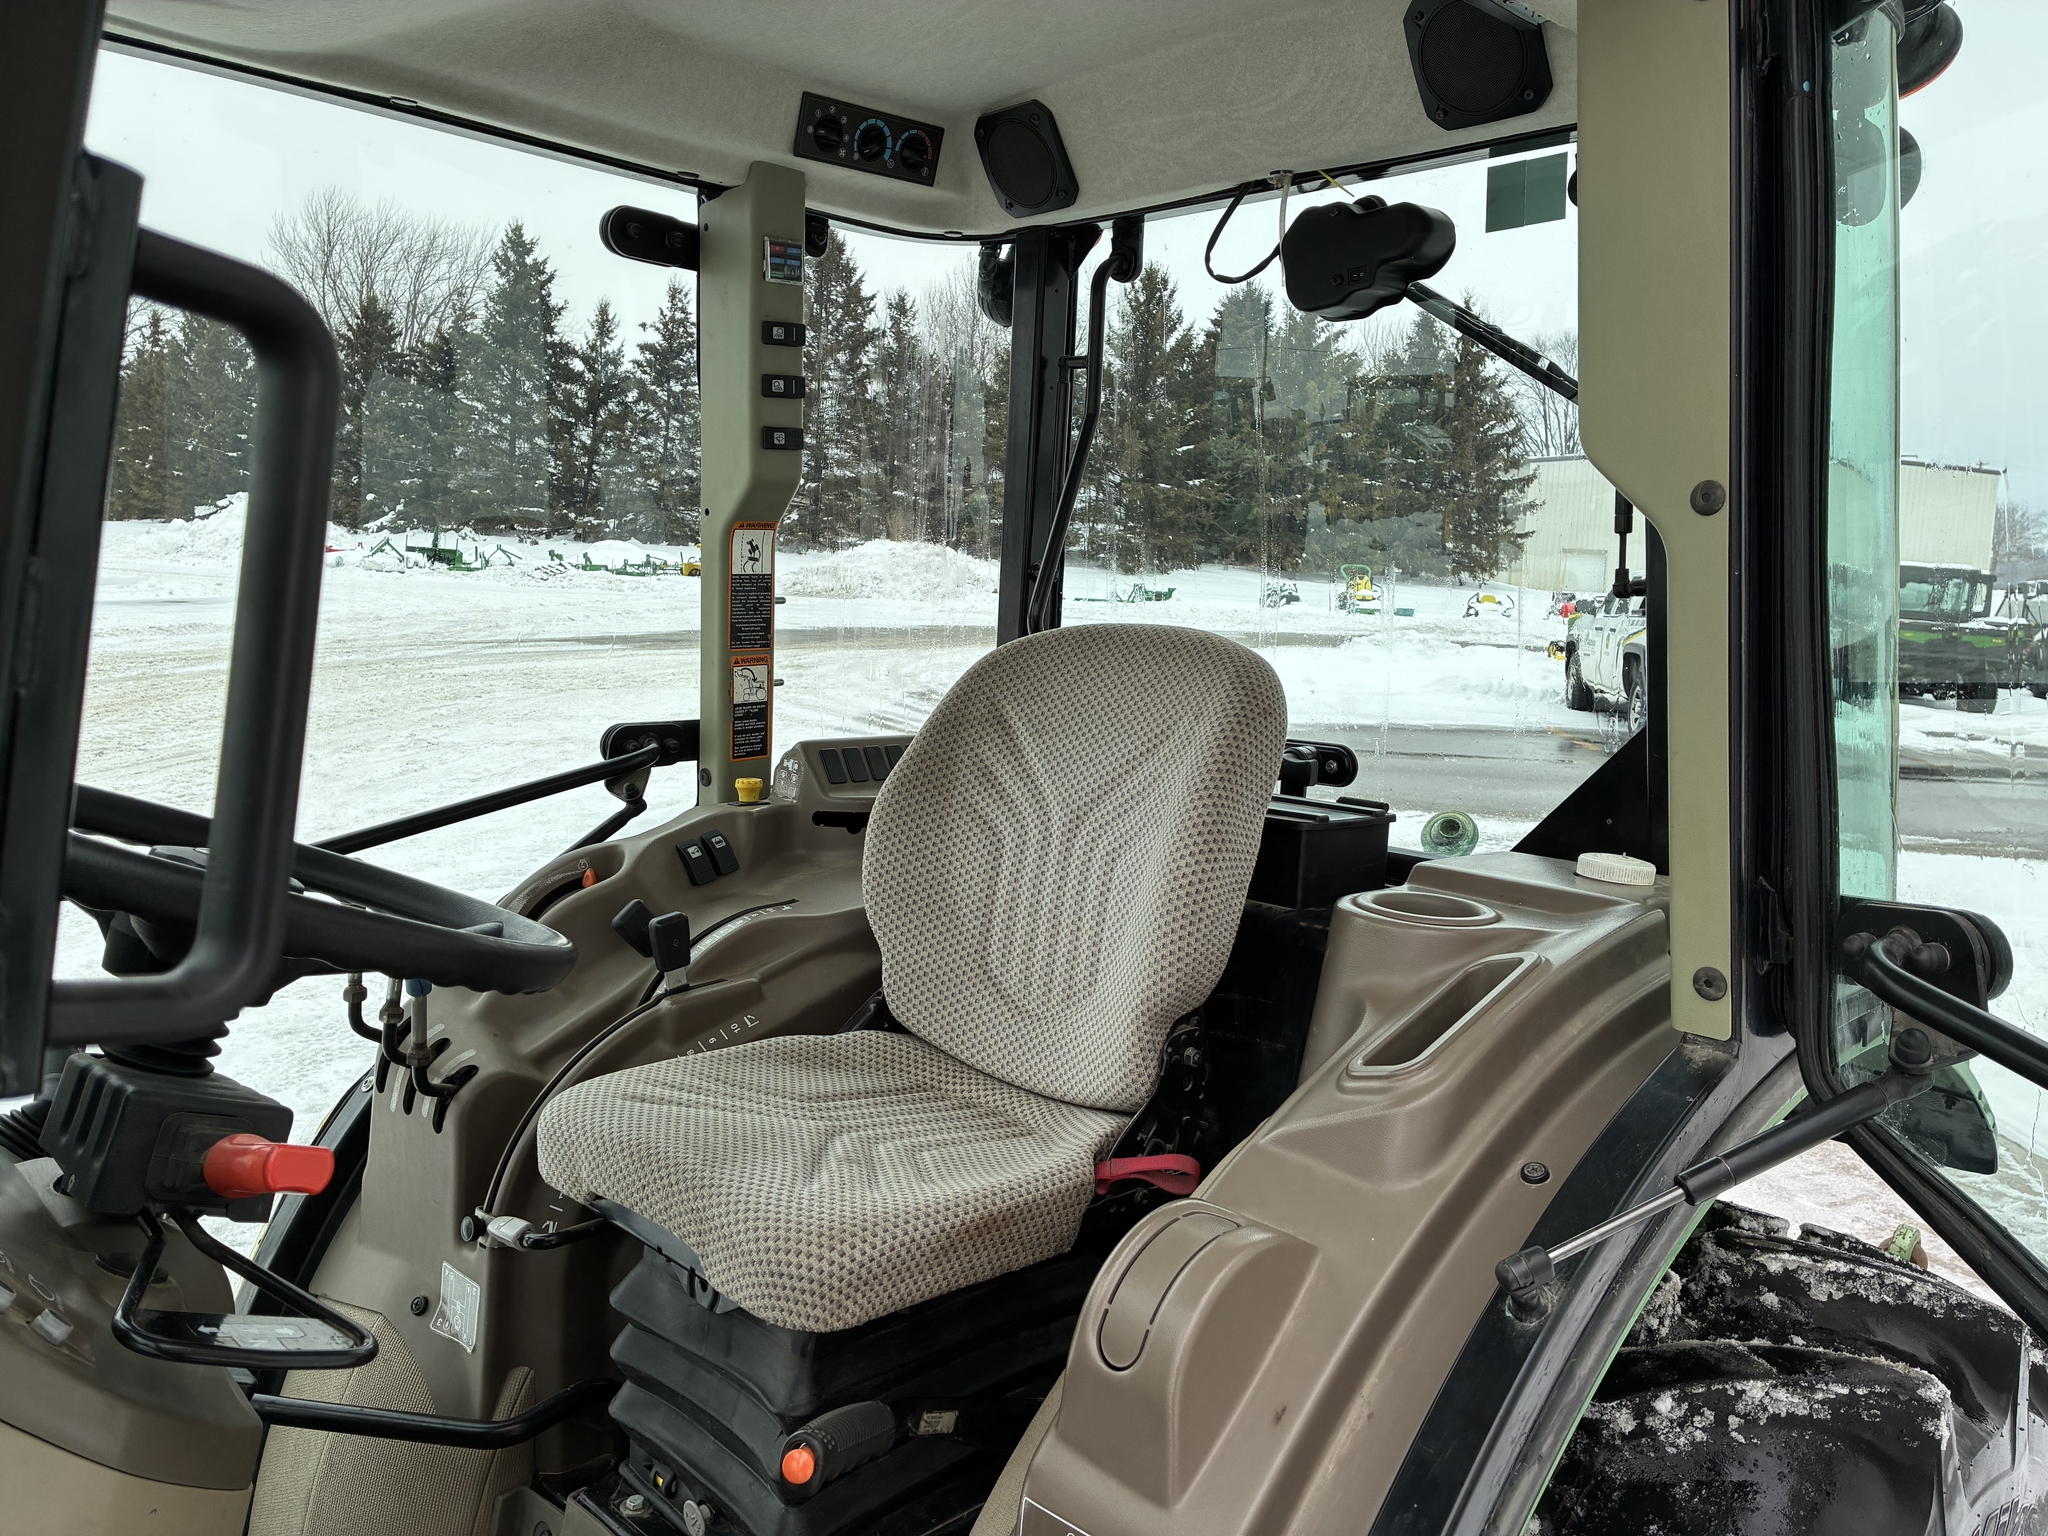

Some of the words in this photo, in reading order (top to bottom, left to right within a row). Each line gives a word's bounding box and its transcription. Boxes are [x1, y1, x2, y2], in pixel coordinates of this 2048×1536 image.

[740, 656, 768, 664] WARNING
[730, 1023, 741, 1033] 10
[436, 1318, 443, 1327] 3
